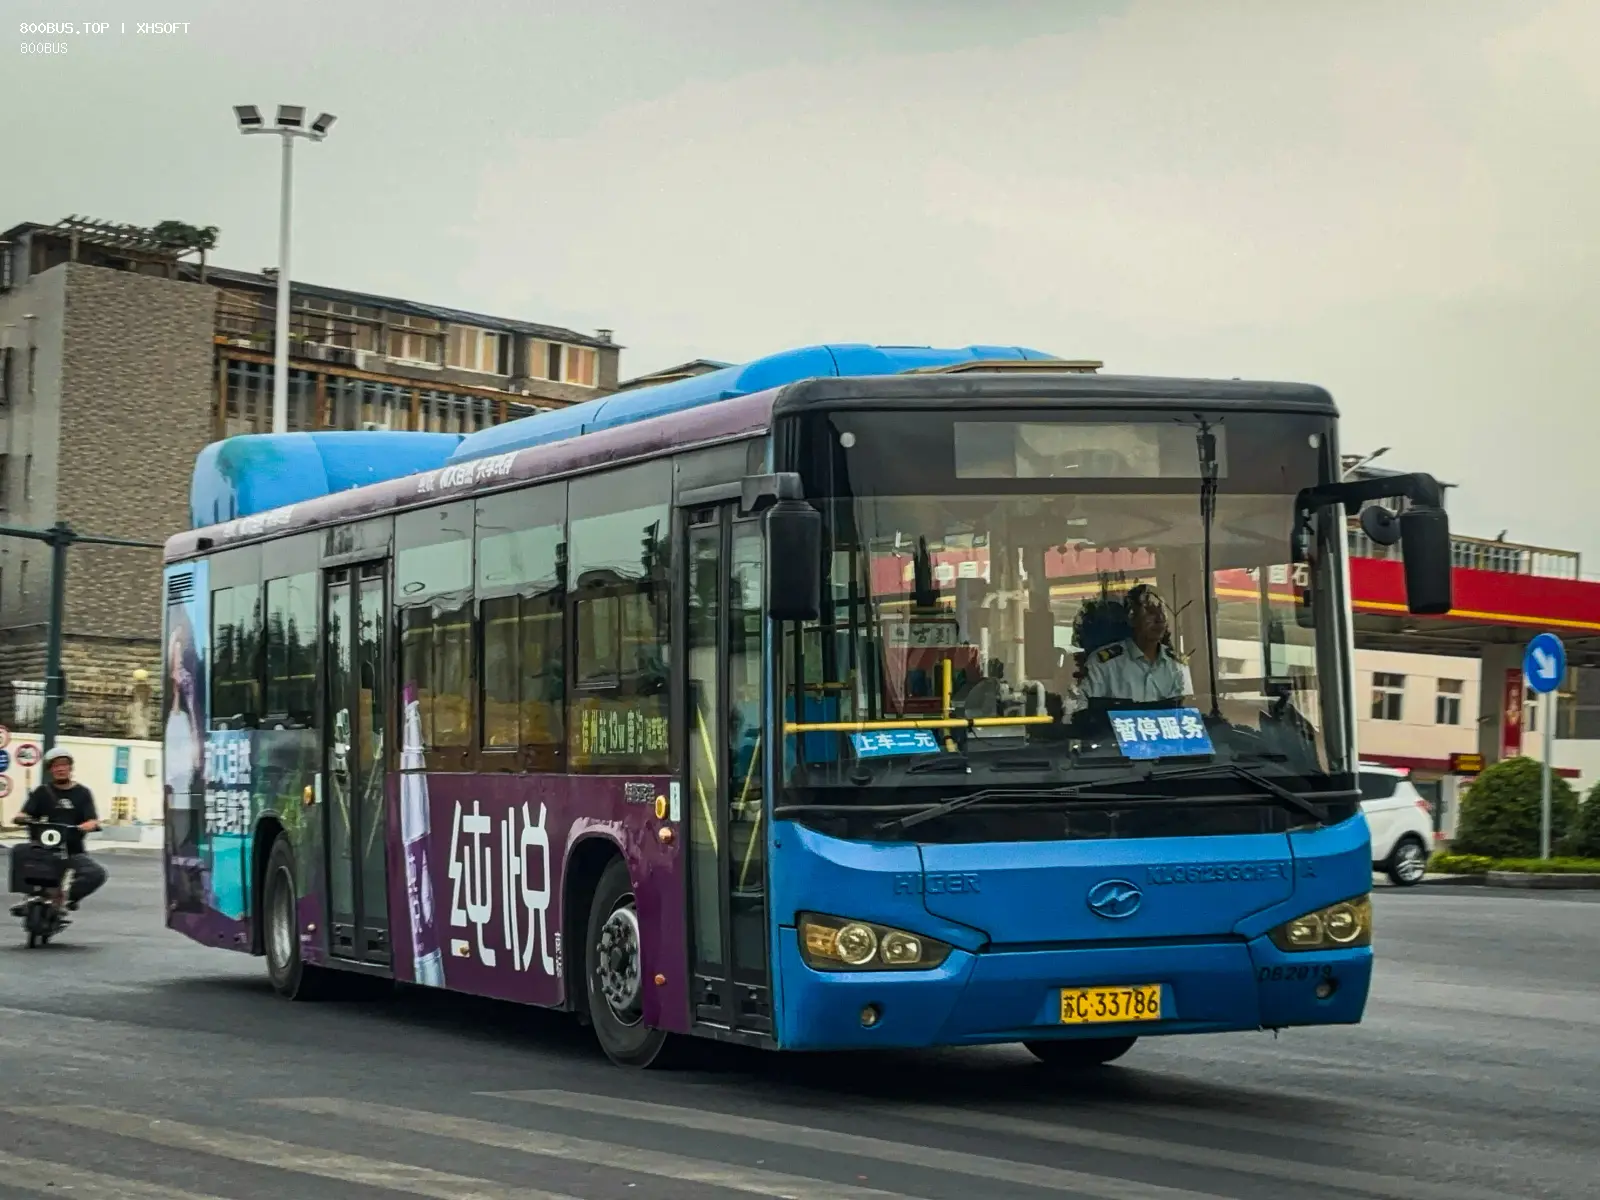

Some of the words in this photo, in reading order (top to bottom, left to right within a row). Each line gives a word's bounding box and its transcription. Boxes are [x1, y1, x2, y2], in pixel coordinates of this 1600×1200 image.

[1112, 714, 1203, 742] 暂停服务
[859, 732, 935, 752] 上车二元
[448, 799, 555, 976] 纯悦
[894, 872, 981, 895] HIGER
